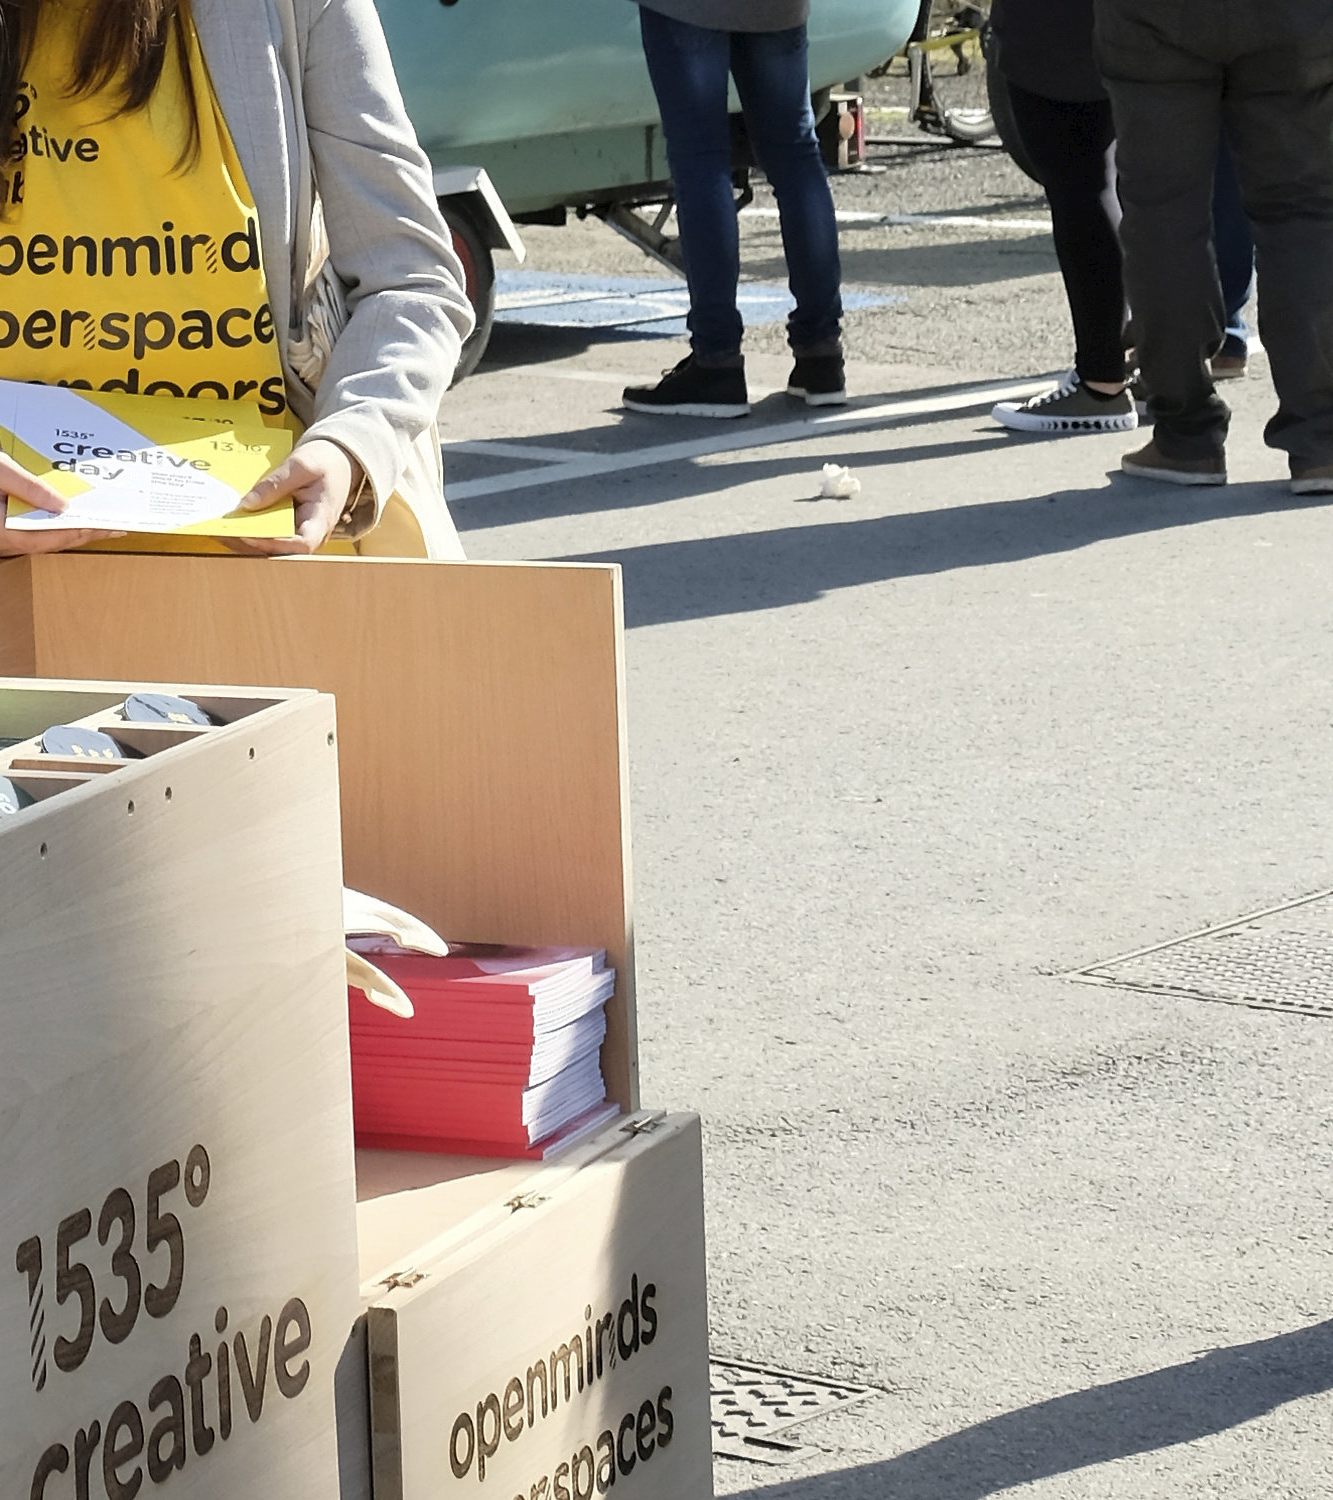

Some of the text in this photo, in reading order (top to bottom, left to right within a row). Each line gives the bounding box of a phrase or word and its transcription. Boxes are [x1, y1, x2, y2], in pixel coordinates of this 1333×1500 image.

[10, 124, 100, 163] ative
[51, 458, 125, 480] day
[52, 441, 213, 472] creative
[448, 1272, 658, 1483] openminds
